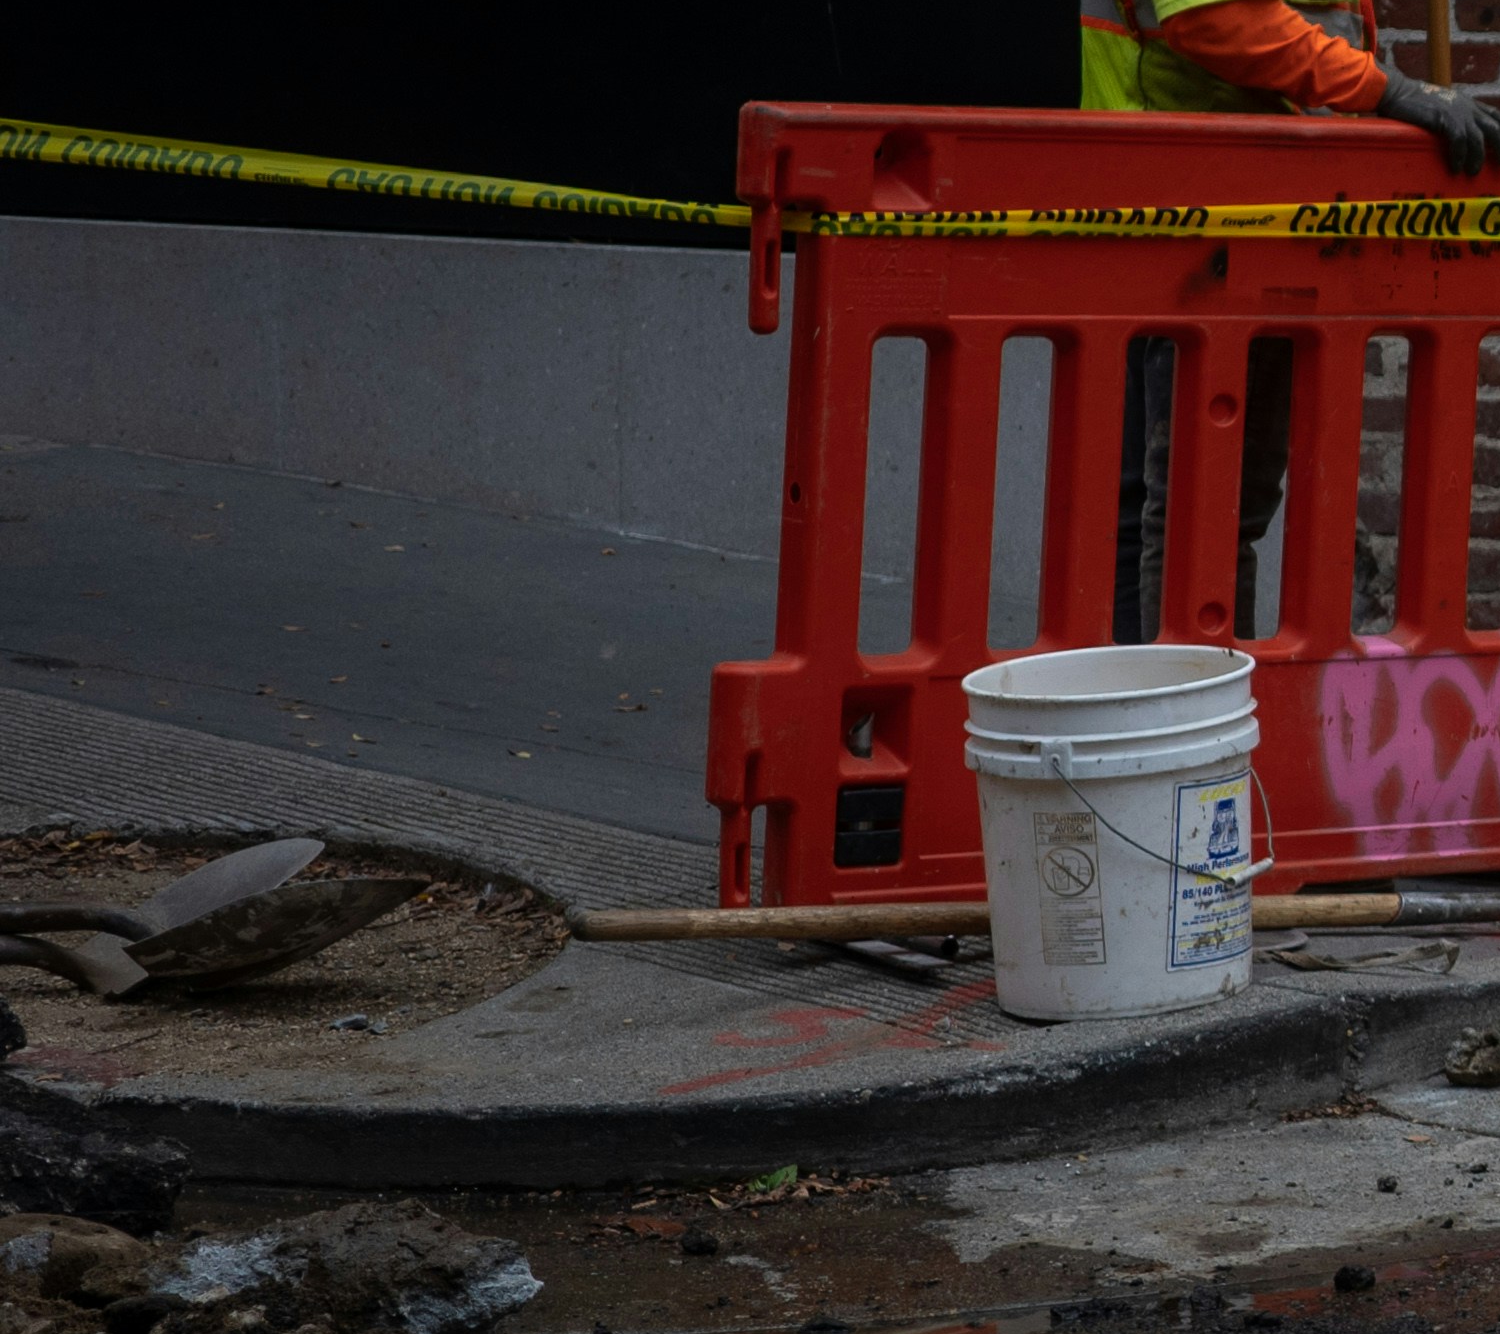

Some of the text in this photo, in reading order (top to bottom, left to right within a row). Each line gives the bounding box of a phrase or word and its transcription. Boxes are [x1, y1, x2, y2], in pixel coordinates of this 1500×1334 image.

[1289, 200, 1465, 237] CAUTION
[1054, 824, 1085, 835] AVISO
[1182, 886, 1213, 900] 85/140
